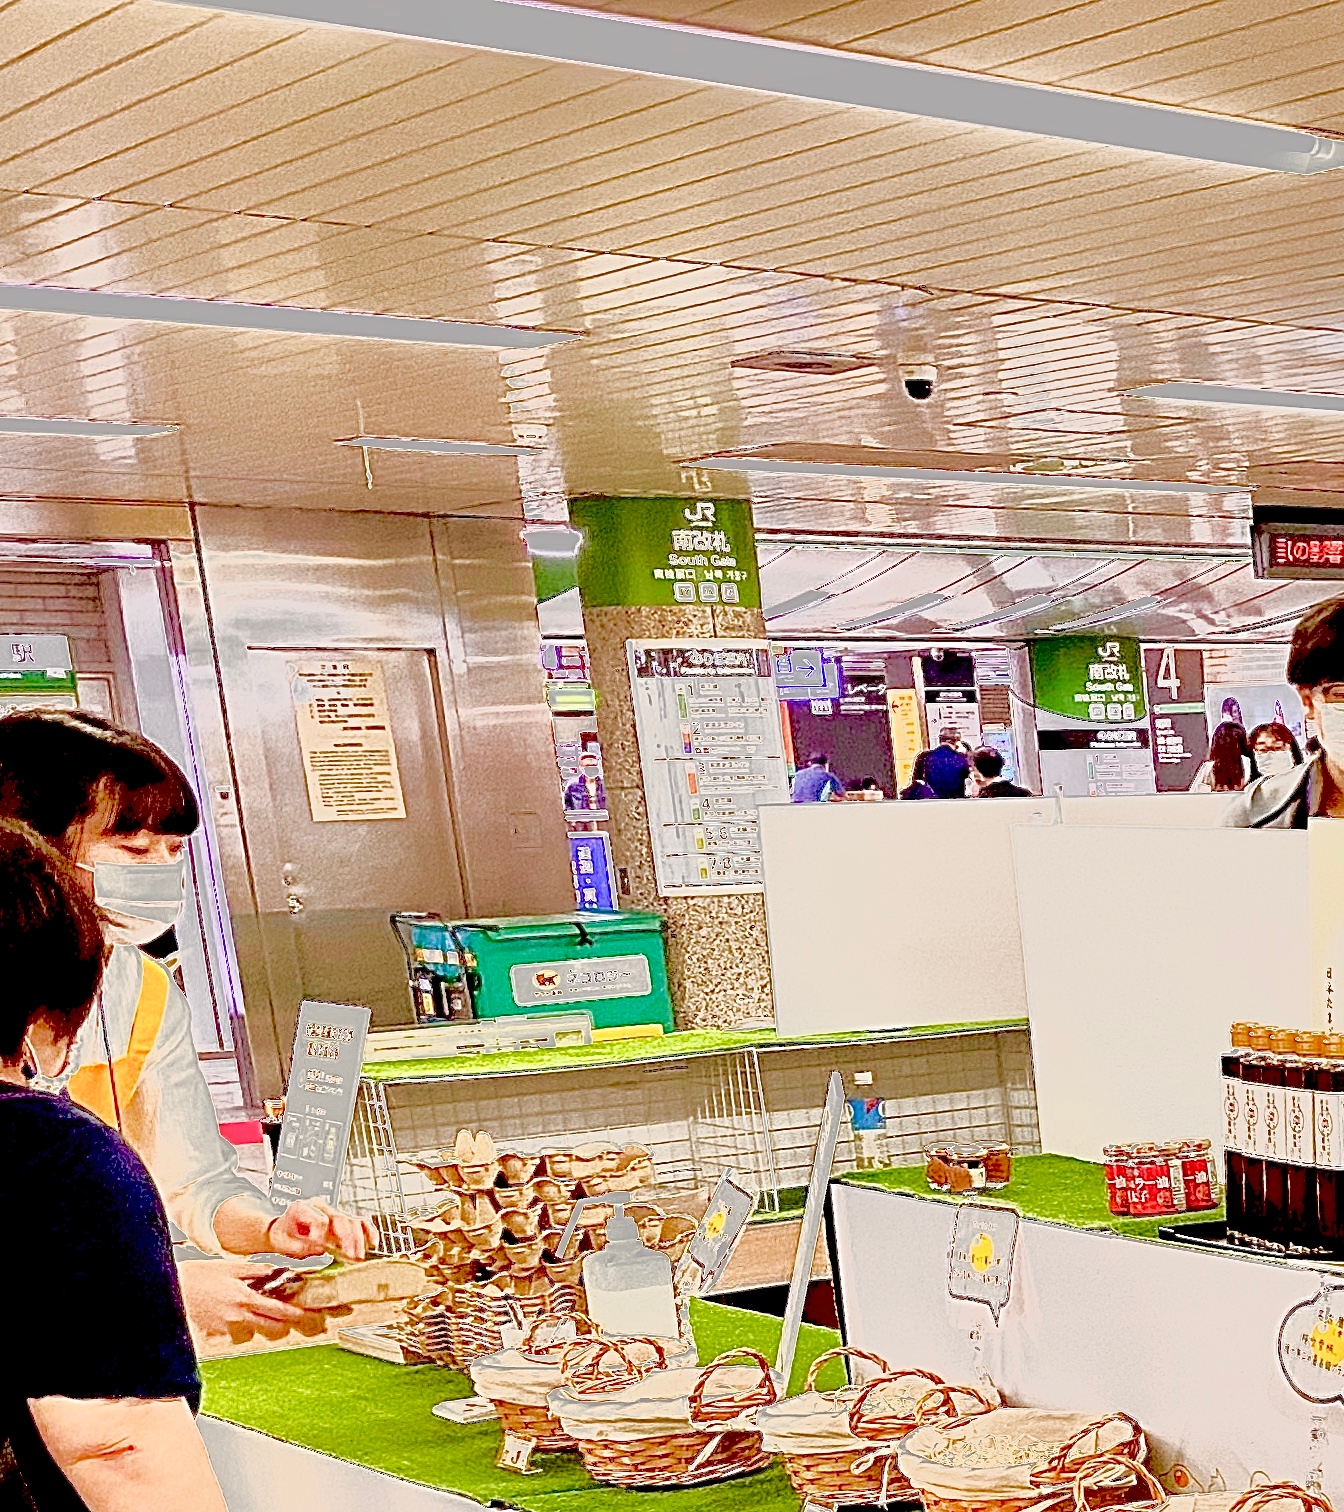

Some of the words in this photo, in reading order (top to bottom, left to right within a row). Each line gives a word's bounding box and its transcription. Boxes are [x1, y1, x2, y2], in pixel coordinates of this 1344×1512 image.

[683, 502, 717, 521] JR
[671, 530, 731, 553] 南改札
[668, 553, 708, 567] South
[710, 554, 737, 567] Gate
[11, 643, 35, 663] 駅
[1157, 646, 1181, 700] 4
[566, 969, 632, 985] ネコロジー
